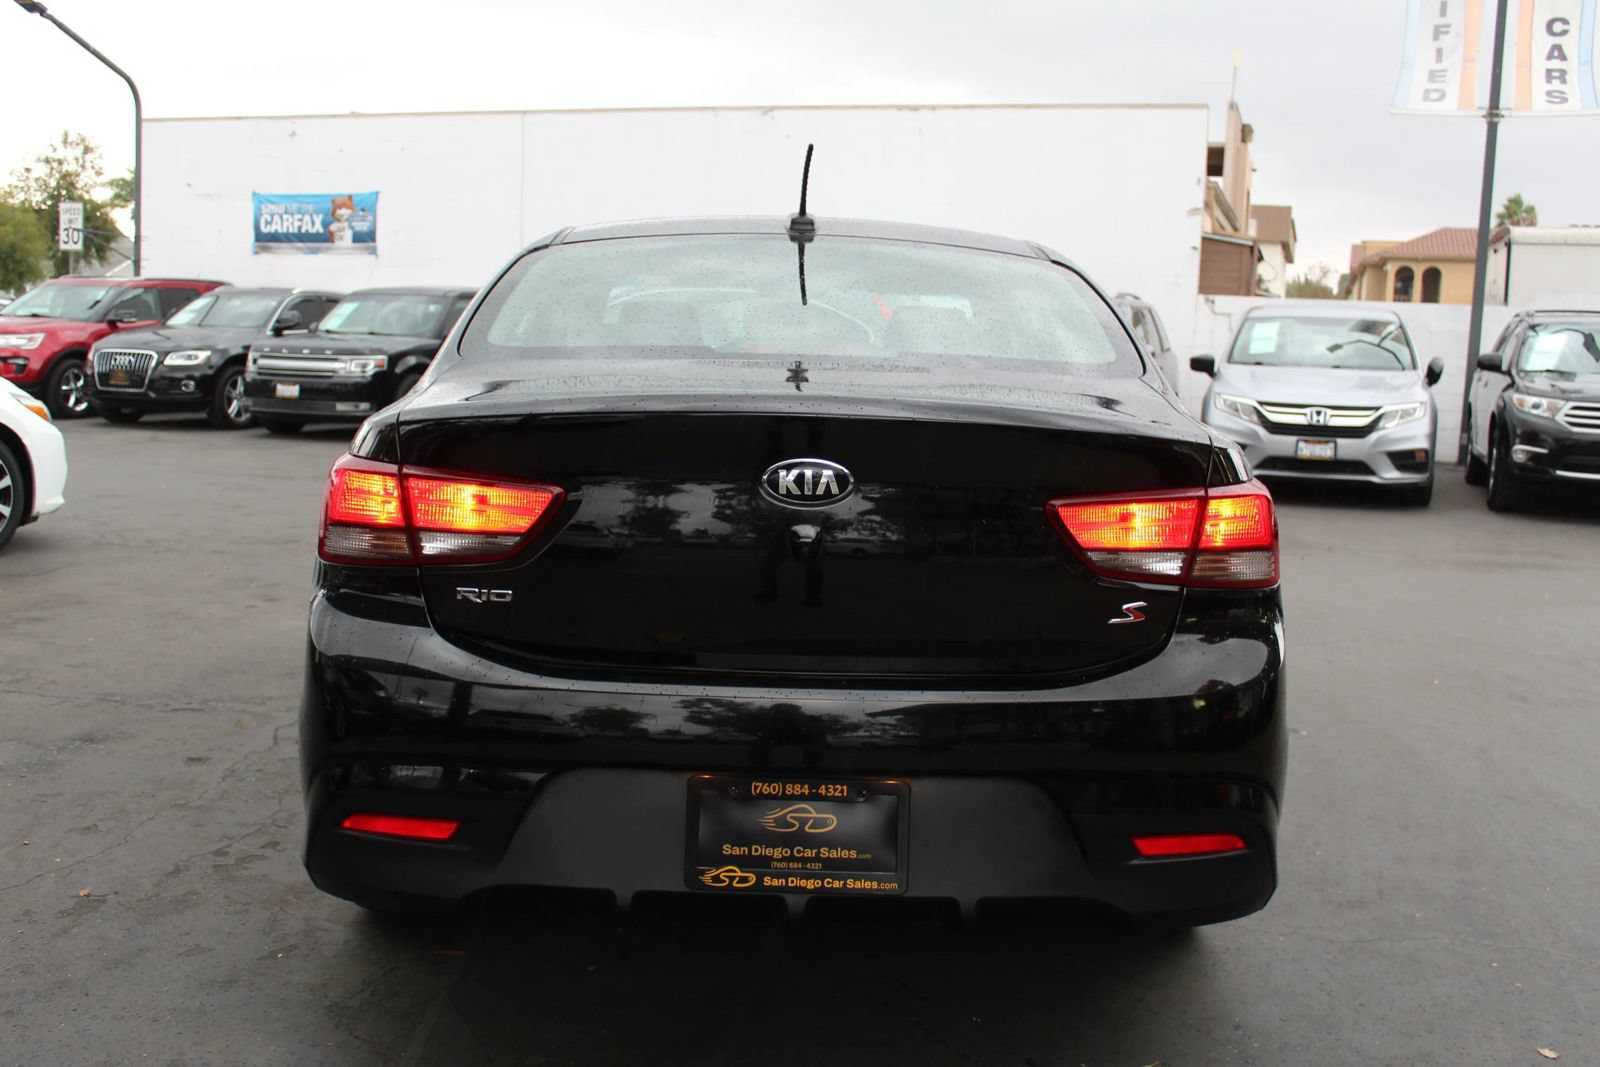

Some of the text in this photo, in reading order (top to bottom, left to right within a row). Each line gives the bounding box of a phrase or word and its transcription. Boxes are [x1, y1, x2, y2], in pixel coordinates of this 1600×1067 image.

[1545, 17, 1570, 105] CARS
[62, 207, 81, 216] SPEED
[260, 213, 324, 233] CARFAX
[63, 227, 80, 244] 30
[778, 469, 840, 495] KIA
[1107, 601, 1148, 624] S
[751, 781, 783, 796] (760)
[785, 783, 810, 795] 884
[818, 784, 848, 796] 4321
[722, 844, 748, 855] San
[751, 845, 791, 859] Diego
[793, 846, 818, 857] Car
[763, 876, 786, 887] San
[788, 877, 822, 890] Diego
[824, 878, 845, 888] Car
